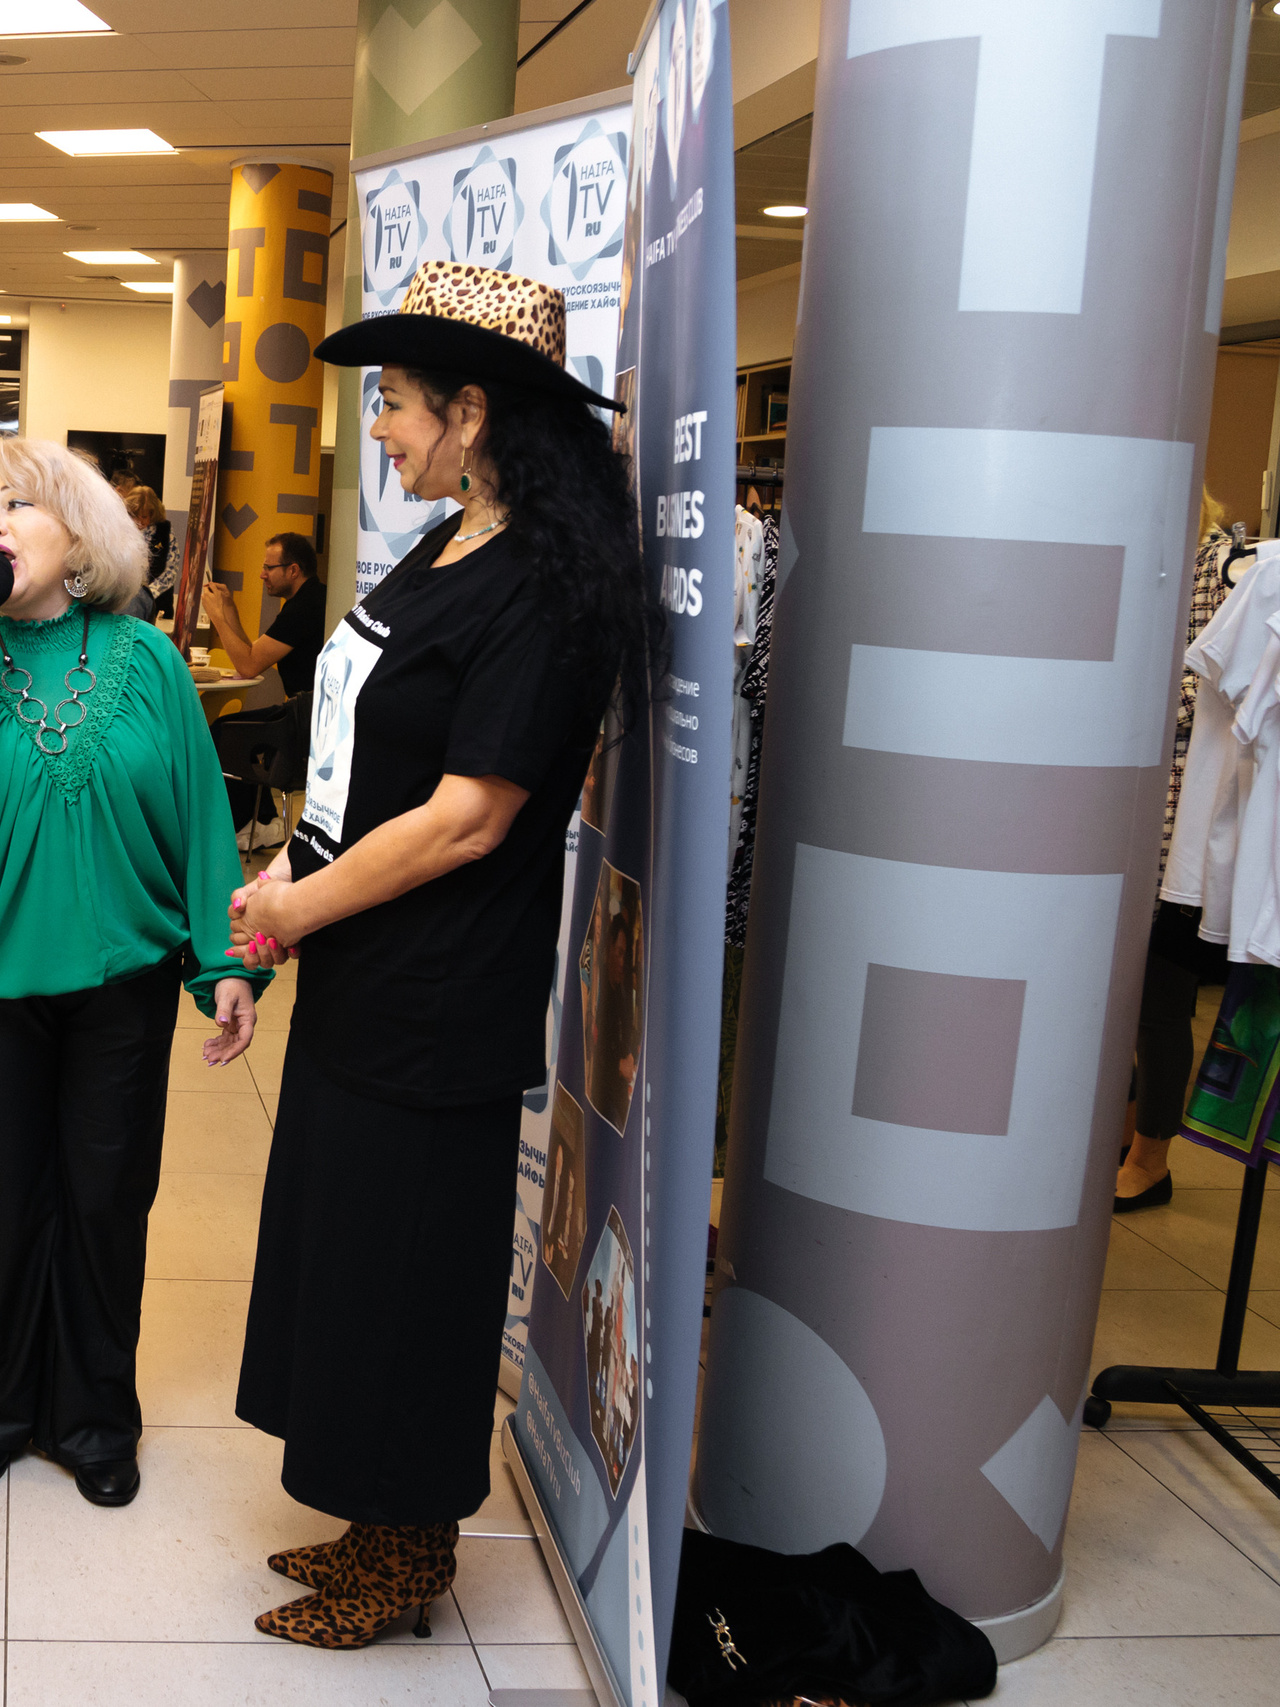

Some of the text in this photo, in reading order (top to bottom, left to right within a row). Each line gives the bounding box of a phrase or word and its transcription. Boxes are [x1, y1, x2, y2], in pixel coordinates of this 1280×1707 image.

[581, 160, 615, 180] HAIFA
[477, 184, 507, 202] HAIFA
[580, 179, 615, 218] TV
[385, 204, 411, 221] HAIFA
[477, 202, 506, 238] TV
[384, 221, 411, 253] TV
[585, 221, 601, 237] RU
[483, 240, 497, 255] RU
[389, 256, 402, 269] RU
[674, 410, 707, 464] BEST
[512, 1282, 524, 1301] RU
